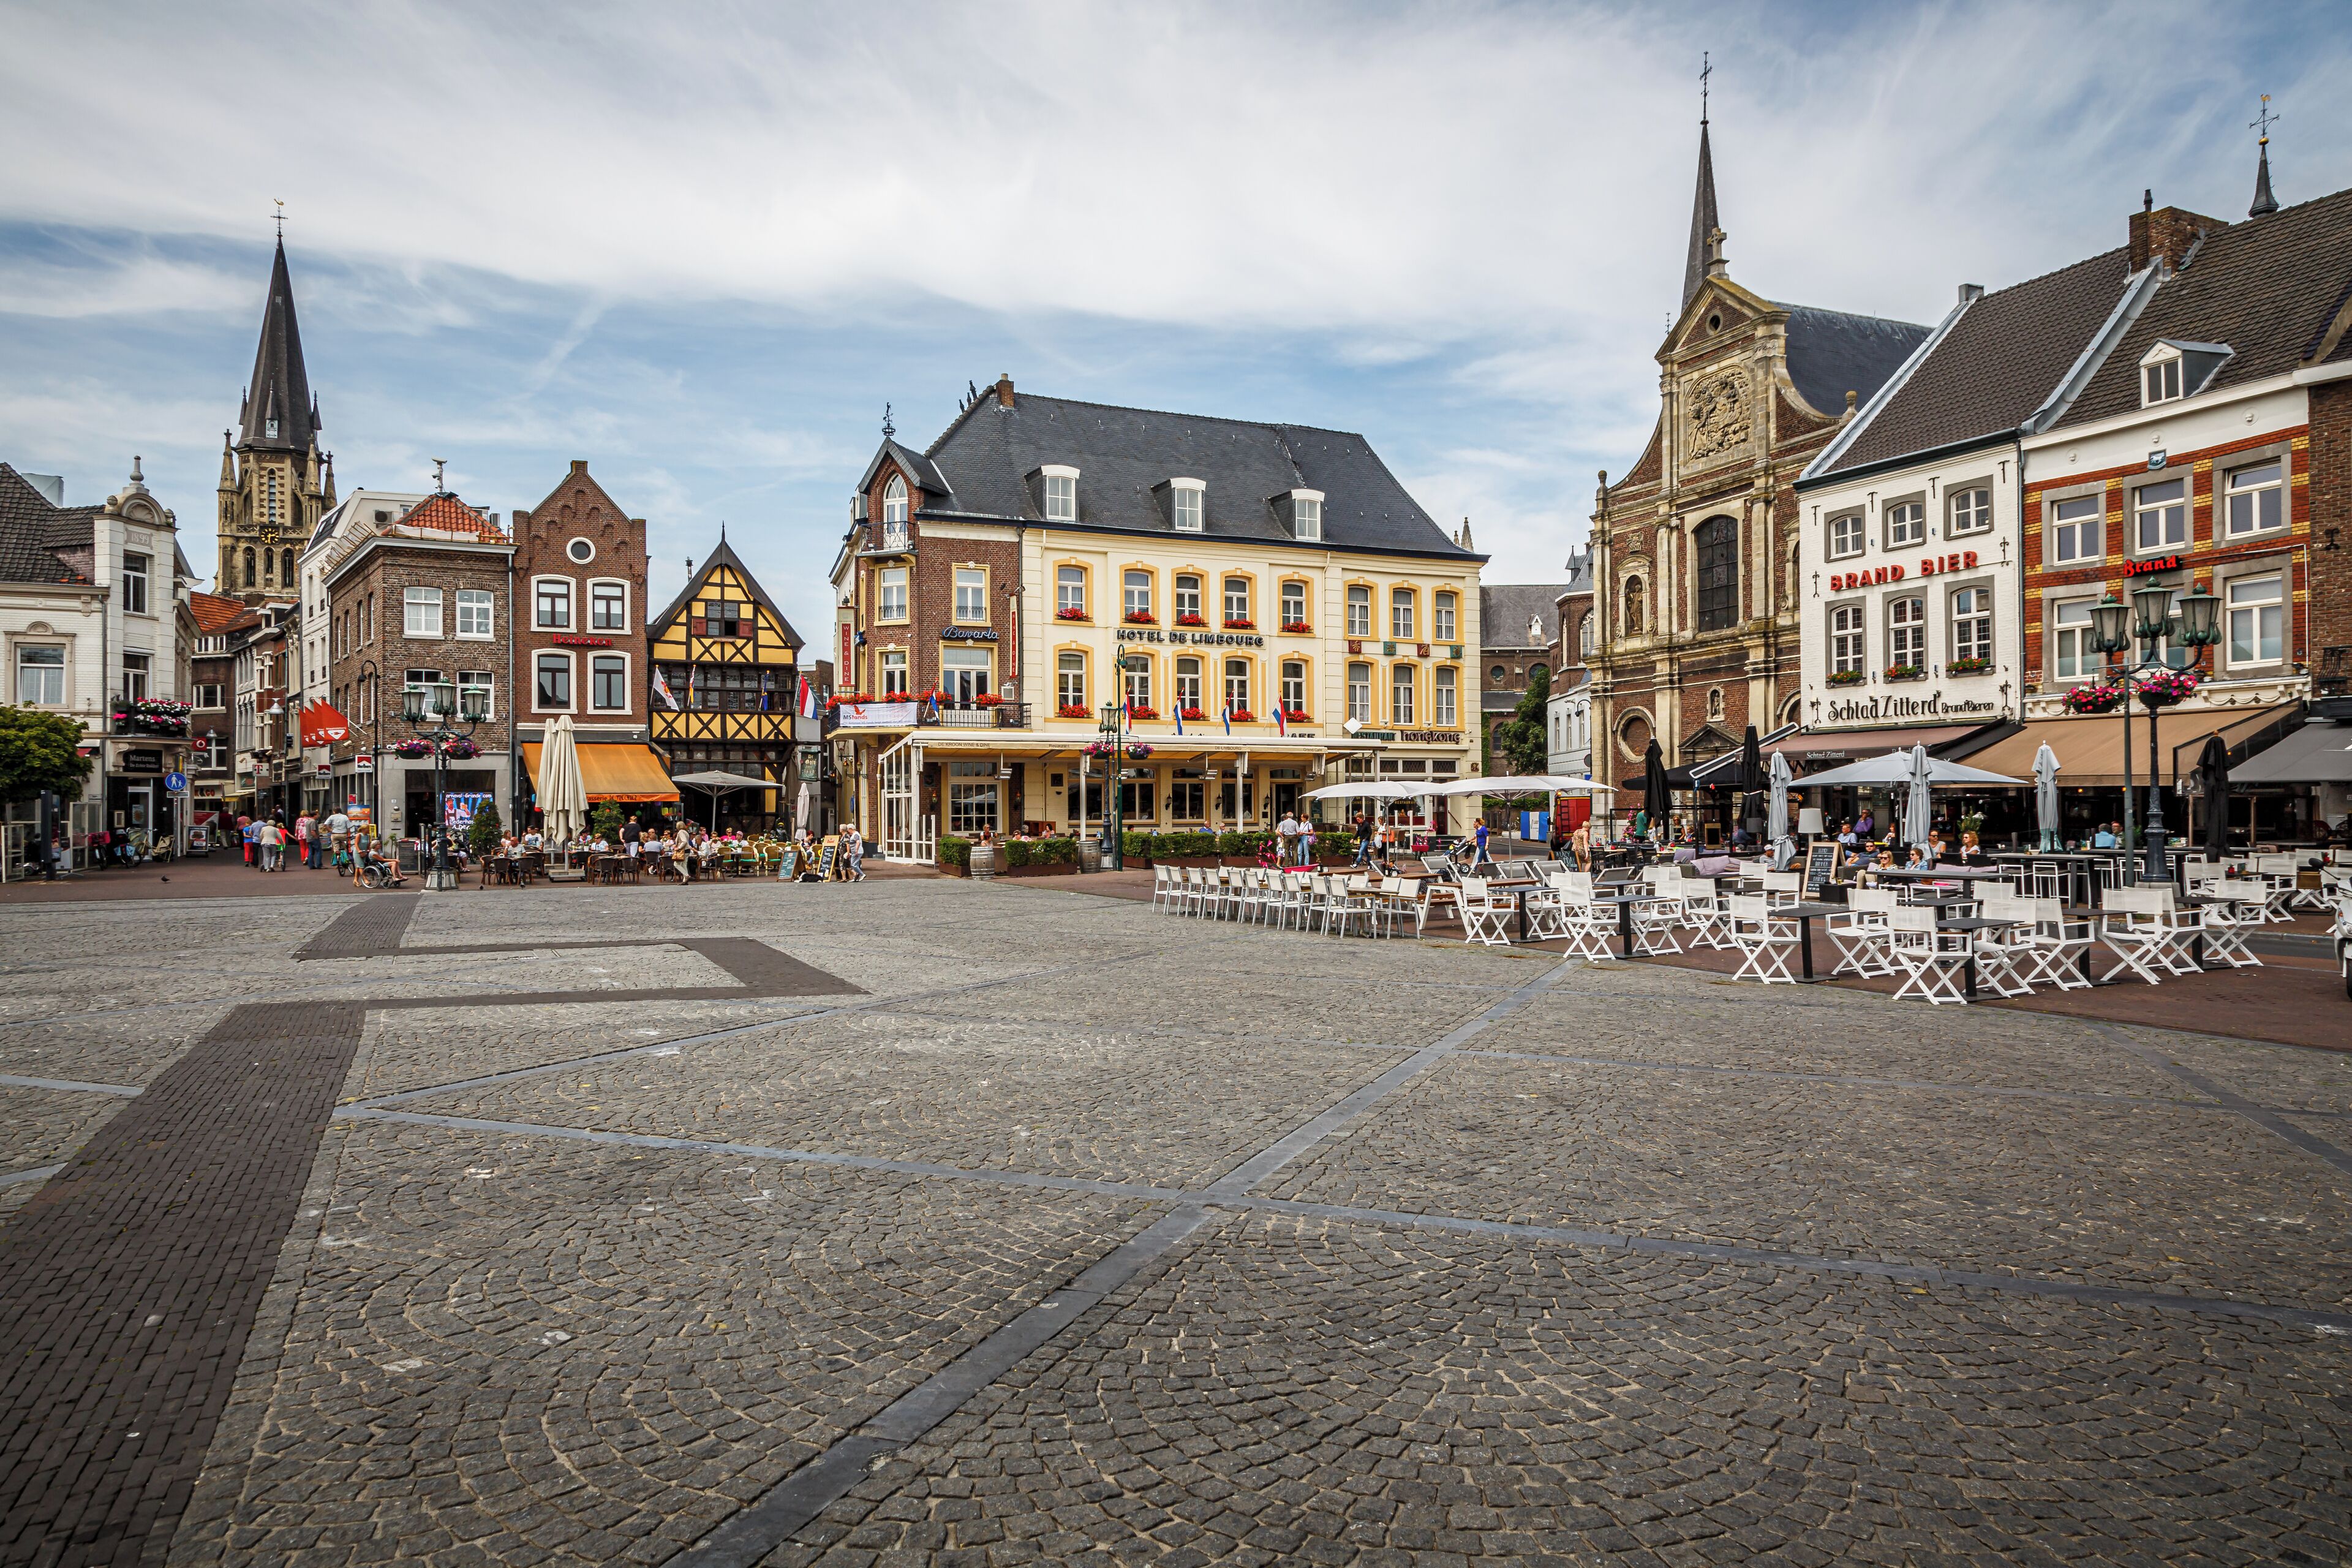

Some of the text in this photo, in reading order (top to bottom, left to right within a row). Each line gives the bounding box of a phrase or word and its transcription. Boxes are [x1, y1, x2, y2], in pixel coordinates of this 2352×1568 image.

[132, 533, 149, 544] 1899
[1830, 551, 1978, 590] BRAND BIER
[2123, 554, 2177, 577] Brand
[553, 633, 612, 646] Heineken
[942, 626, 999, 639] Bavaria
[1117, 630, 1264, 646] HOTEL DE LIMBOURG
[1828, 698, 1879, 722] Schtad
[1880, 694, 1939, 717] Zitterd
